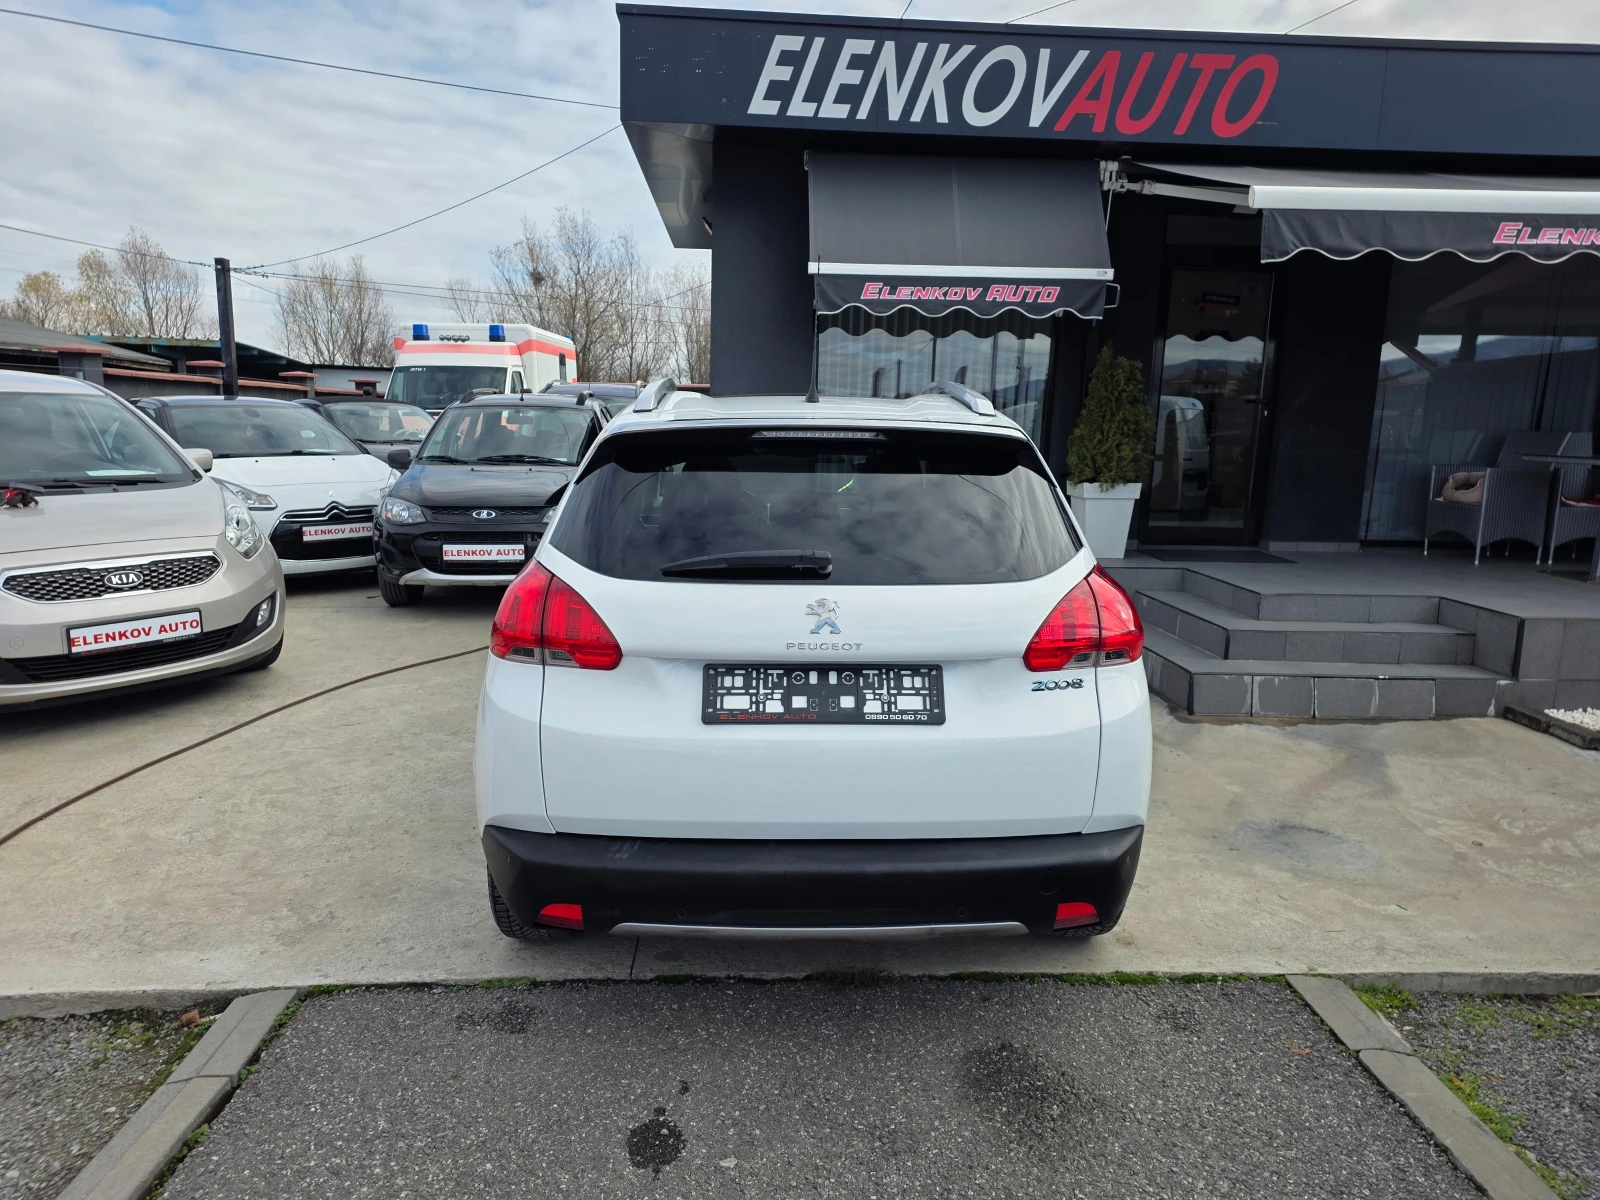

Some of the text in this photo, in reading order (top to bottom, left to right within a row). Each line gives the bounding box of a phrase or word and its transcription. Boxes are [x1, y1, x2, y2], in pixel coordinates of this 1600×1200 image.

[861, 282, 1061, 303] ELENKOV AUTO
[302, 526, 372, 537] ELENKOV AUTO
[443, 548, 525, 557] ELENKOV AUTO
[110, 573, 139, 585] KIA
[71, 626, 153, 648] ELENKOV
[157, 619, 200, 635] AUTO
[786, 642, 863, 651] PEUGEOT
[1031, 678, 1084, 692] 2008
